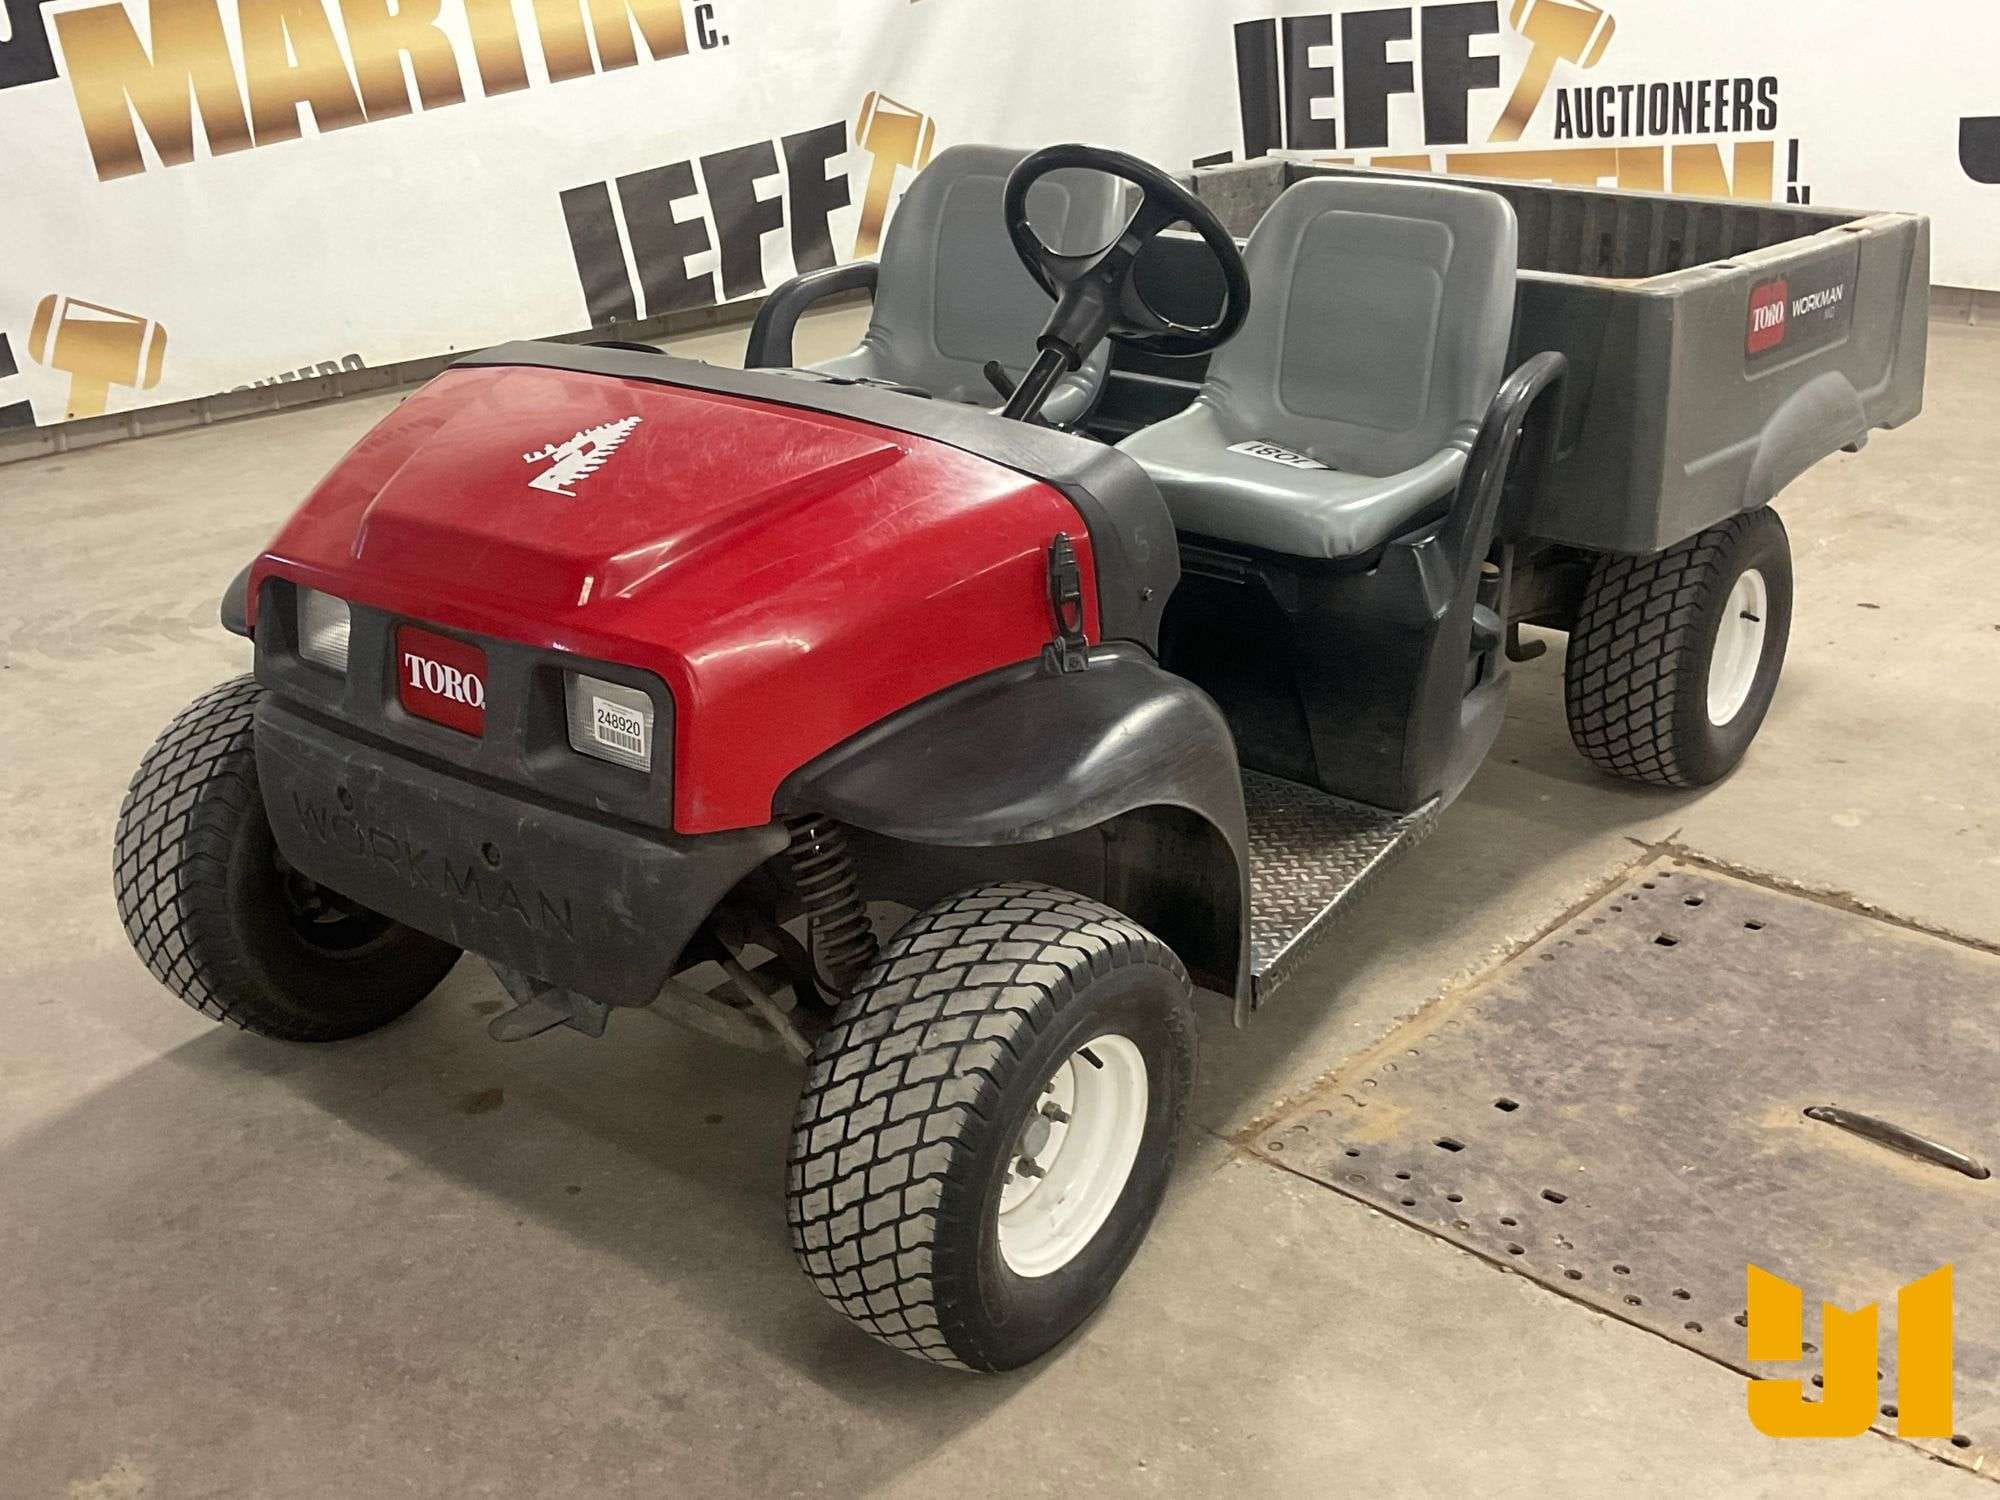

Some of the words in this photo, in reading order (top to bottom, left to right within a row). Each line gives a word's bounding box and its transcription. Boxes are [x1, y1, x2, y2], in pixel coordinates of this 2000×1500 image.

[1193, 1, 1500, 169] JEFF
[1554, 75, 1778, 139] AUCTIONEERS
[1752, 300, 1785, 332] TORO
[1792, 283, 1845, 318] WORKMAN
[404, 652, 486, 710] TORO
[597, 708, 641, 737] 248920
[293, 790, 577, 943] WORKMAN
